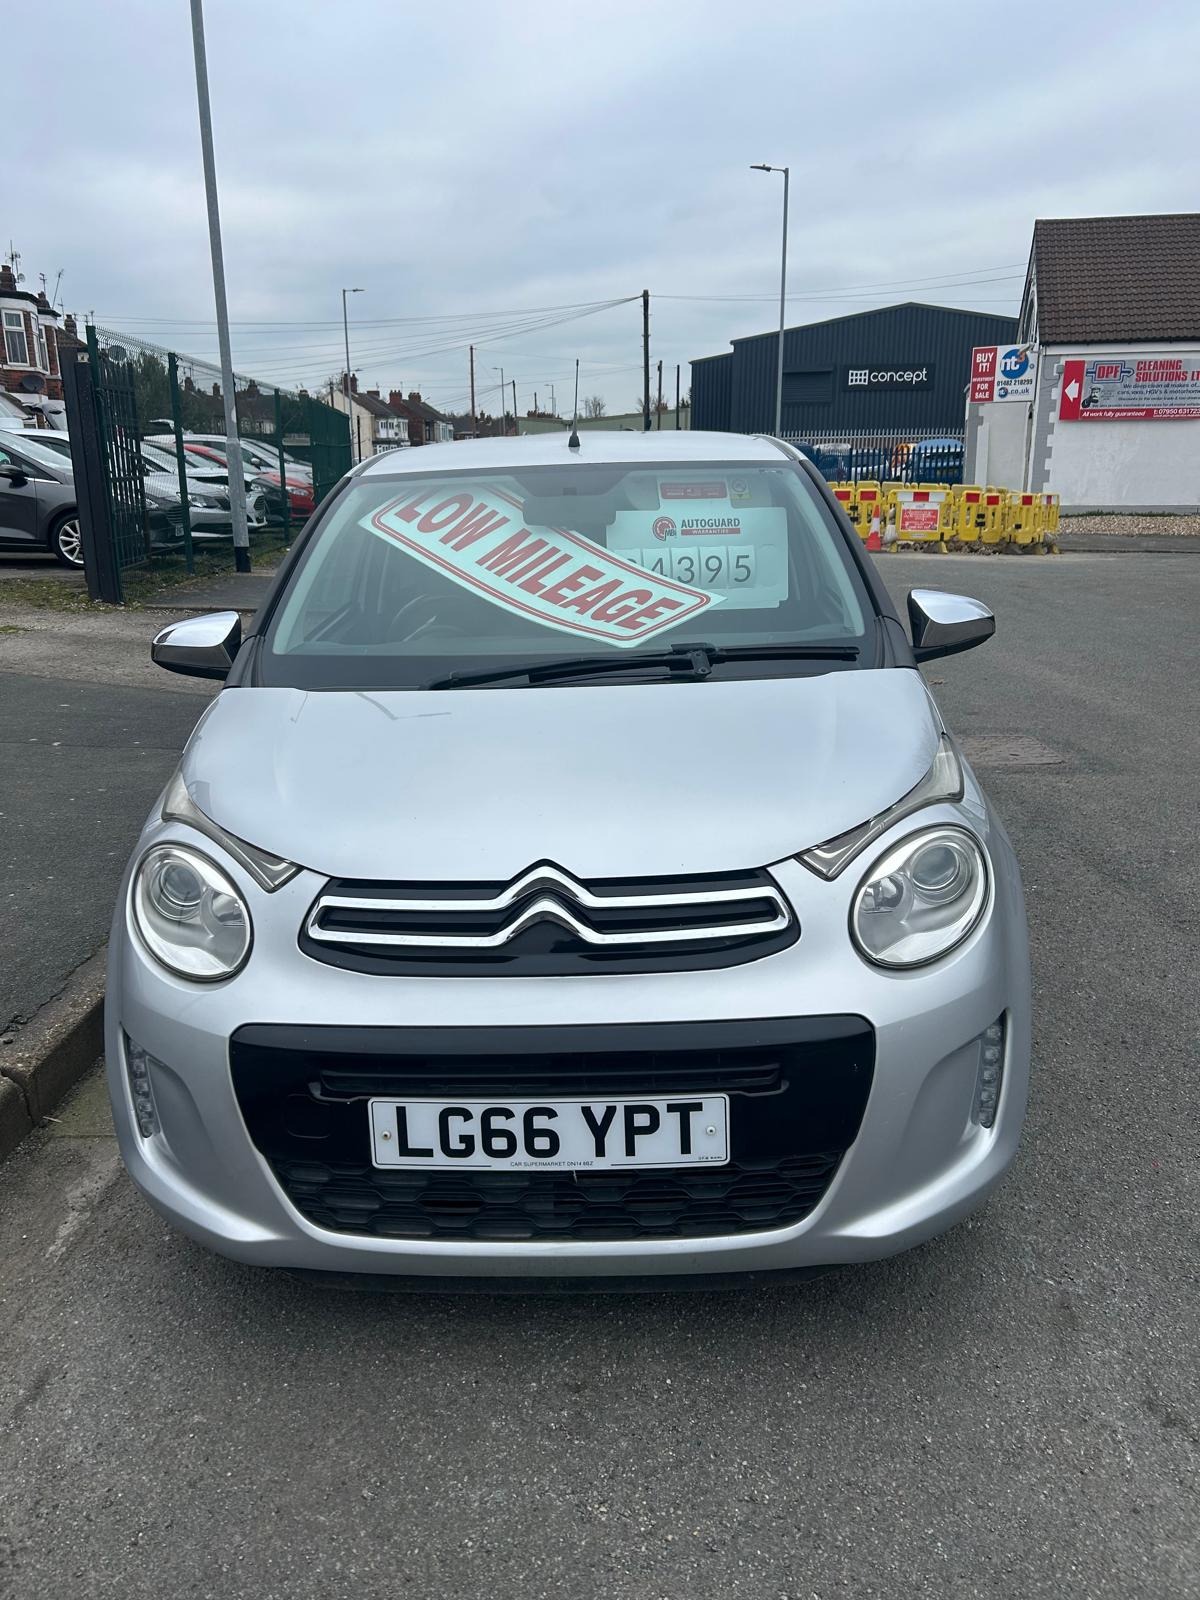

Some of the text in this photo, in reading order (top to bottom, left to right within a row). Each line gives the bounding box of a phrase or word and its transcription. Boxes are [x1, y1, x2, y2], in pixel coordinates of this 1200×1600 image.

[976, 353, 994, 362] BUY
[978, 362, 990, 372] IT!
[1136, 360, 1183, 371] CLEANING
[870, 368, 927, 384] concept
[1135, 370, 1189, 382] SOLUTIONS
[976, 383, 989, 391] FOR
[974, 391, 990, 399] SALE
[1104, 410, 1114, 418] fully
[1114, 410, 1146, 418] guaranteed
[681, 518, 740, 529] AUTOGUARD
[394, 485, 686, 631] LOW MILEAGE
[627, 554, 752, 584] 4395
[396, 1102, 703, 1158] LG66 YPT
